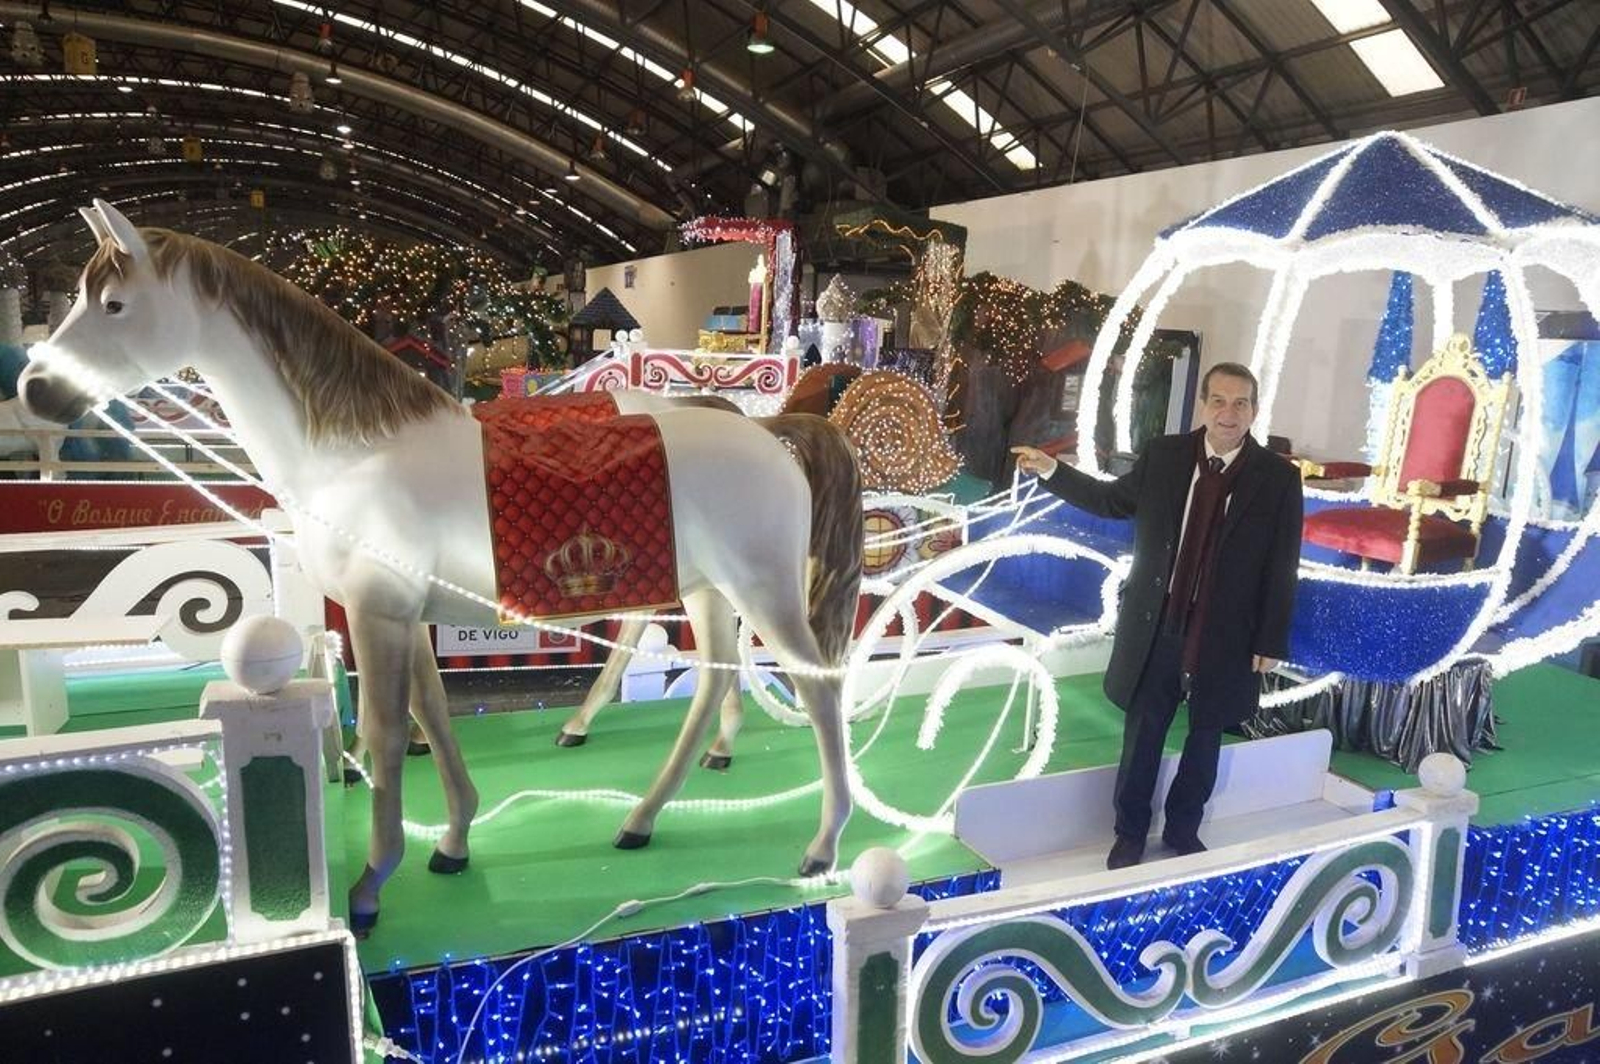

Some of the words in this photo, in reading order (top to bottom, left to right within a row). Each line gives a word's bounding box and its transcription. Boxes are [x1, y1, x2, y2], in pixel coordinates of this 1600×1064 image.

[71, 499, 150, 526] Bosque
[157, 498, 264, 526] Encand
[458, 630, 477, 641] DE
[483, 629, 519, 640] VIGO
